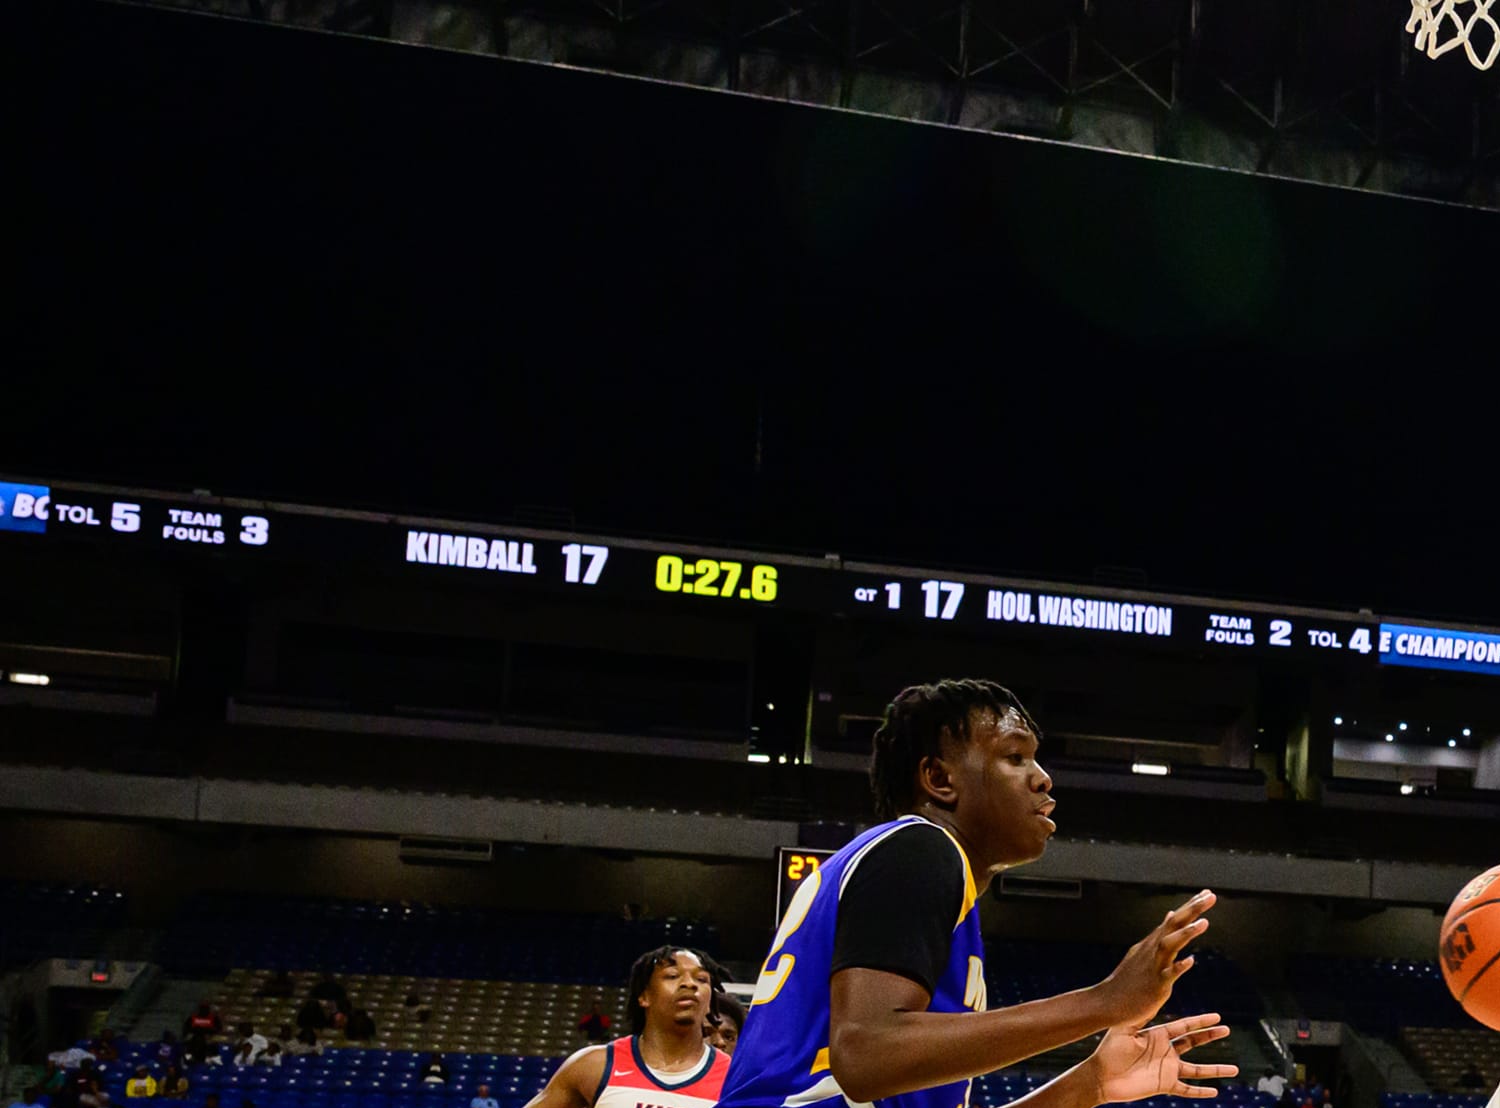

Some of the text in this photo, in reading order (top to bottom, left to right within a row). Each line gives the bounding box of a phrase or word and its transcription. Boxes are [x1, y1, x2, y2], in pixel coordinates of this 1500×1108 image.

[55, 502, 141, 532] TOL 5
[168, 509, 222, 527] TEAM
[162, 525, 225, 544] FOULS
[239, 516, 269, 545] 3
[406, 531, 608, 584] KIMBALL 17
[656, 555, 777, 601] 0:27.6
[884, 583, 901, 609] 1
[921, 580, 1172, 636] 17 HOU. WASHINGTON
[1209, 615, 1251, 630] TEAM
[1269, 620, 1292, 646] 2
[1205, 629, 1254, 645] FOULS
[1308, 628, 1371, 653] TOL 4
